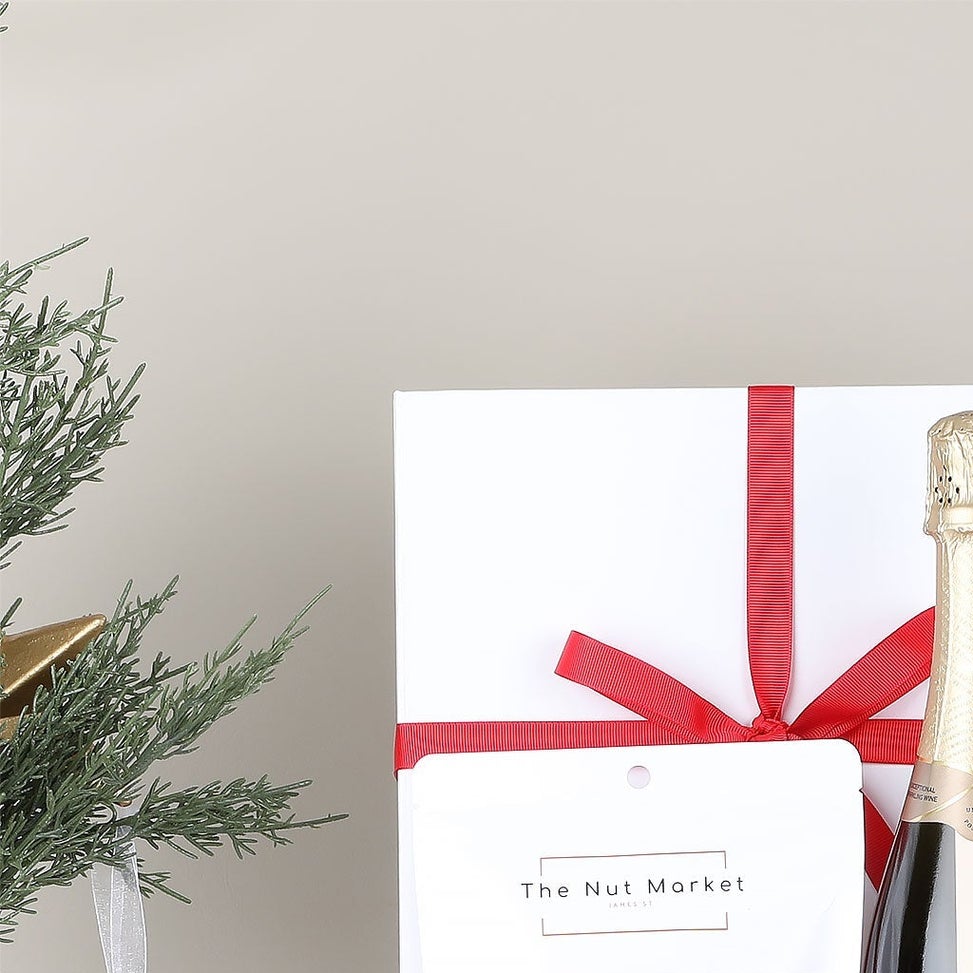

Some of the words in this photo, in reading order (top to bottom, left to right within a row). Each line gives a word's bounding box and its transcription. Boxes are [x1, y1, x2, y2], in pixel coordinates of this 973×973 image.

[521, 882, 569, 899] The
[585, 880, 632, 897] Nut
[648, 876, 744, 894] Market
[608, 901, 639, 909] JAMES
[642, 900, 653, 908] ST
